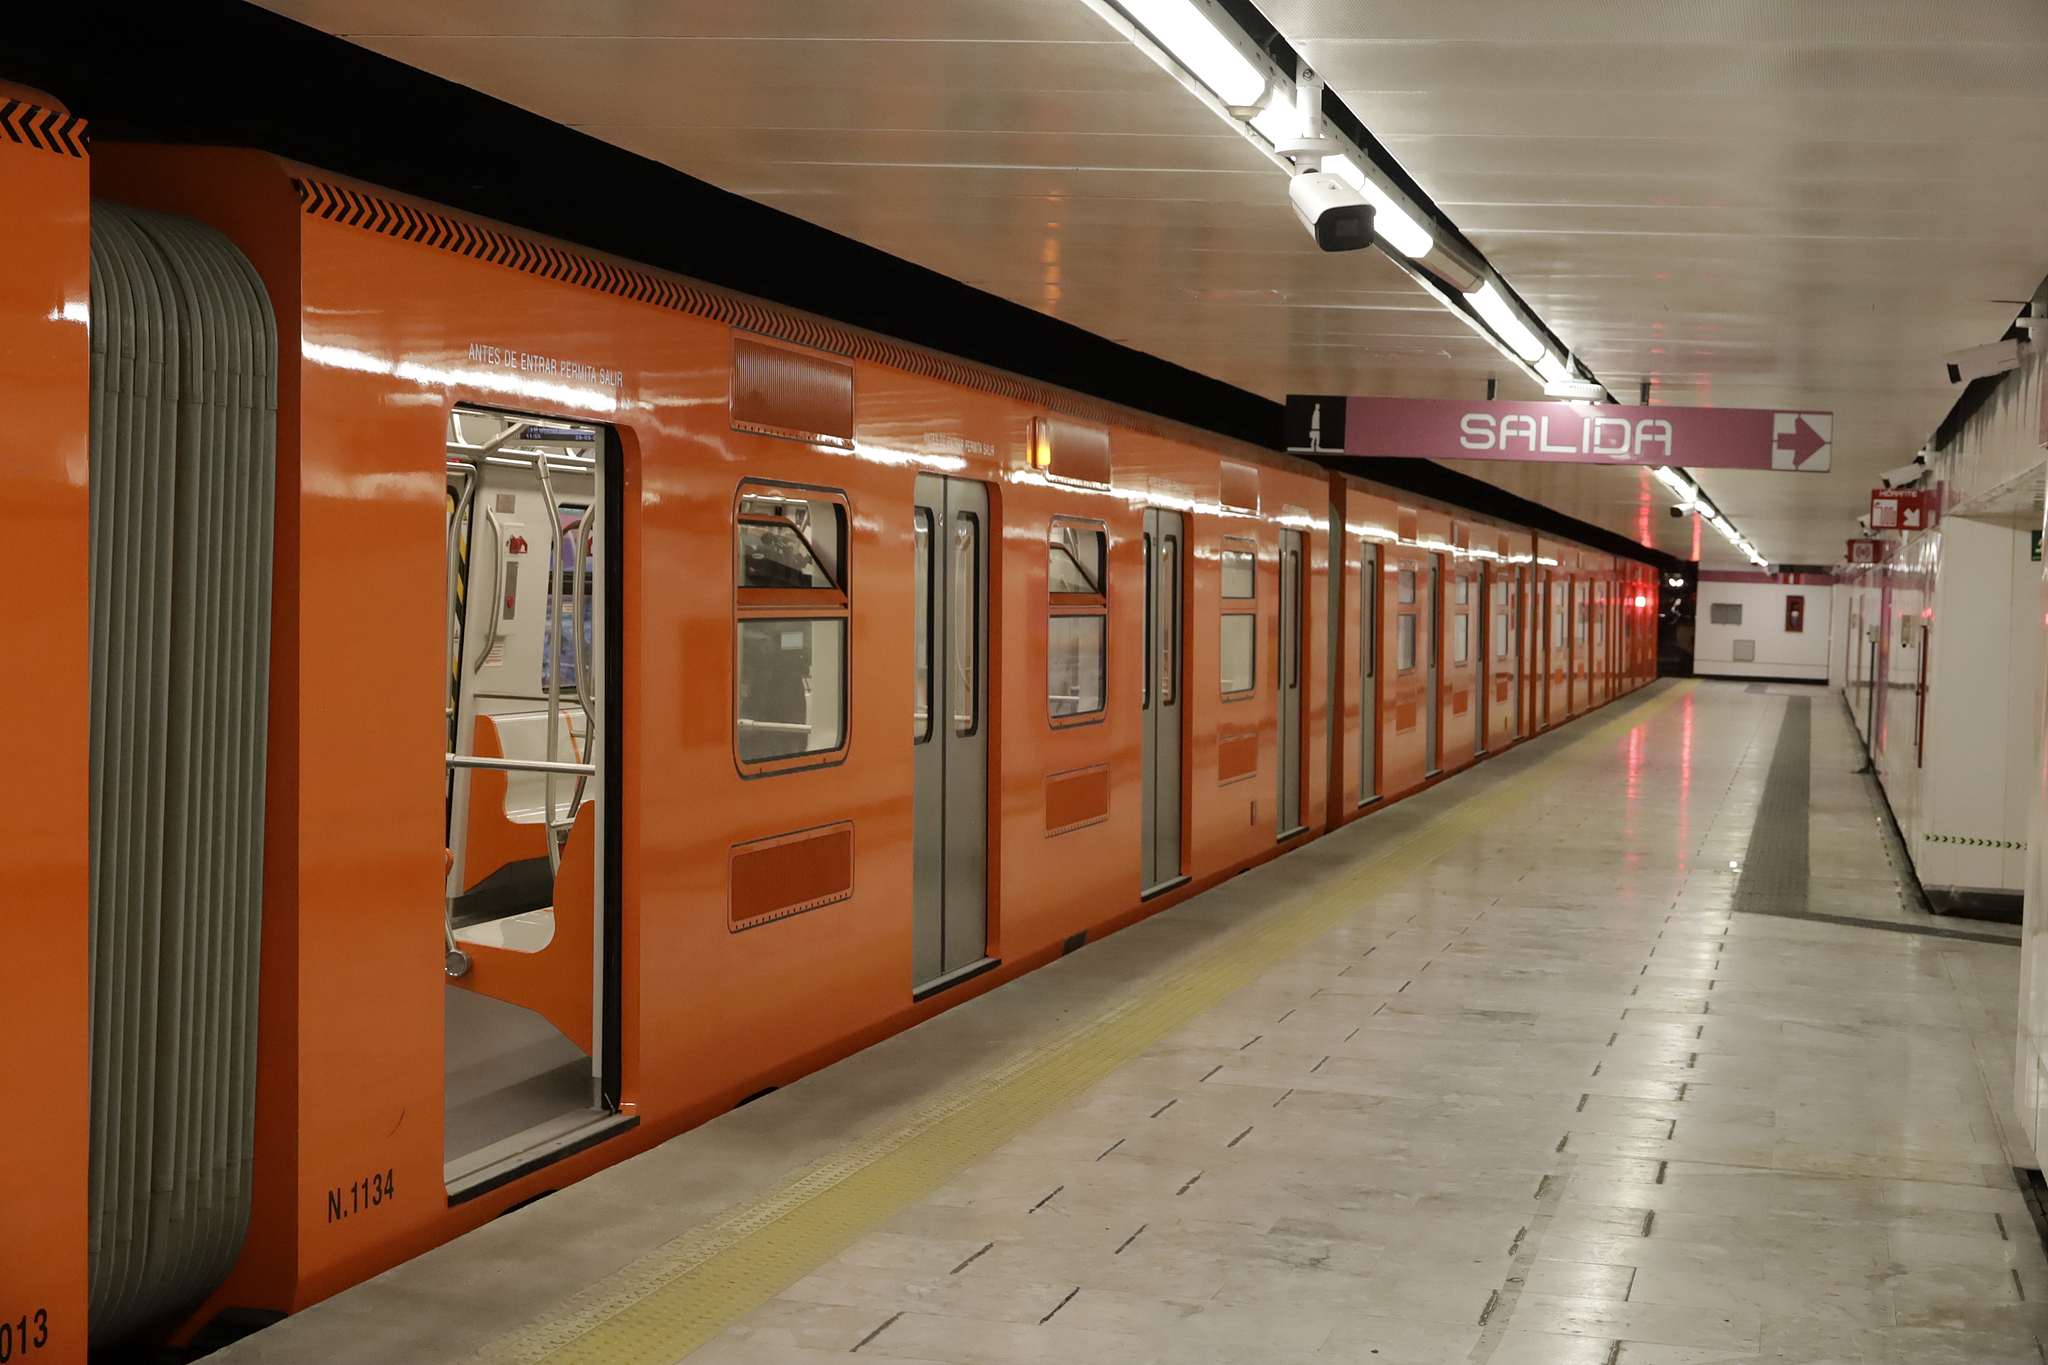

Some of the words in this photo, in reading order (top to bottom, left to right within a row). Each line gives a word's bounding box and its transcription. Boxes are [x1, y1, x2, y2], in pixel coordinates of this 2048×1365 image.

[468, 342, 501, 365] ANTES
[504, 349, 518, 368] DE
[520, 352, 557, 375] ENTRAR
[560, 360, 597, 383] PERMITA
[600, 368, 623, 387] SALIR
[1459, 412, 1673, 457] SALIDA
[328, 1168, 394, 1224] N.1134
